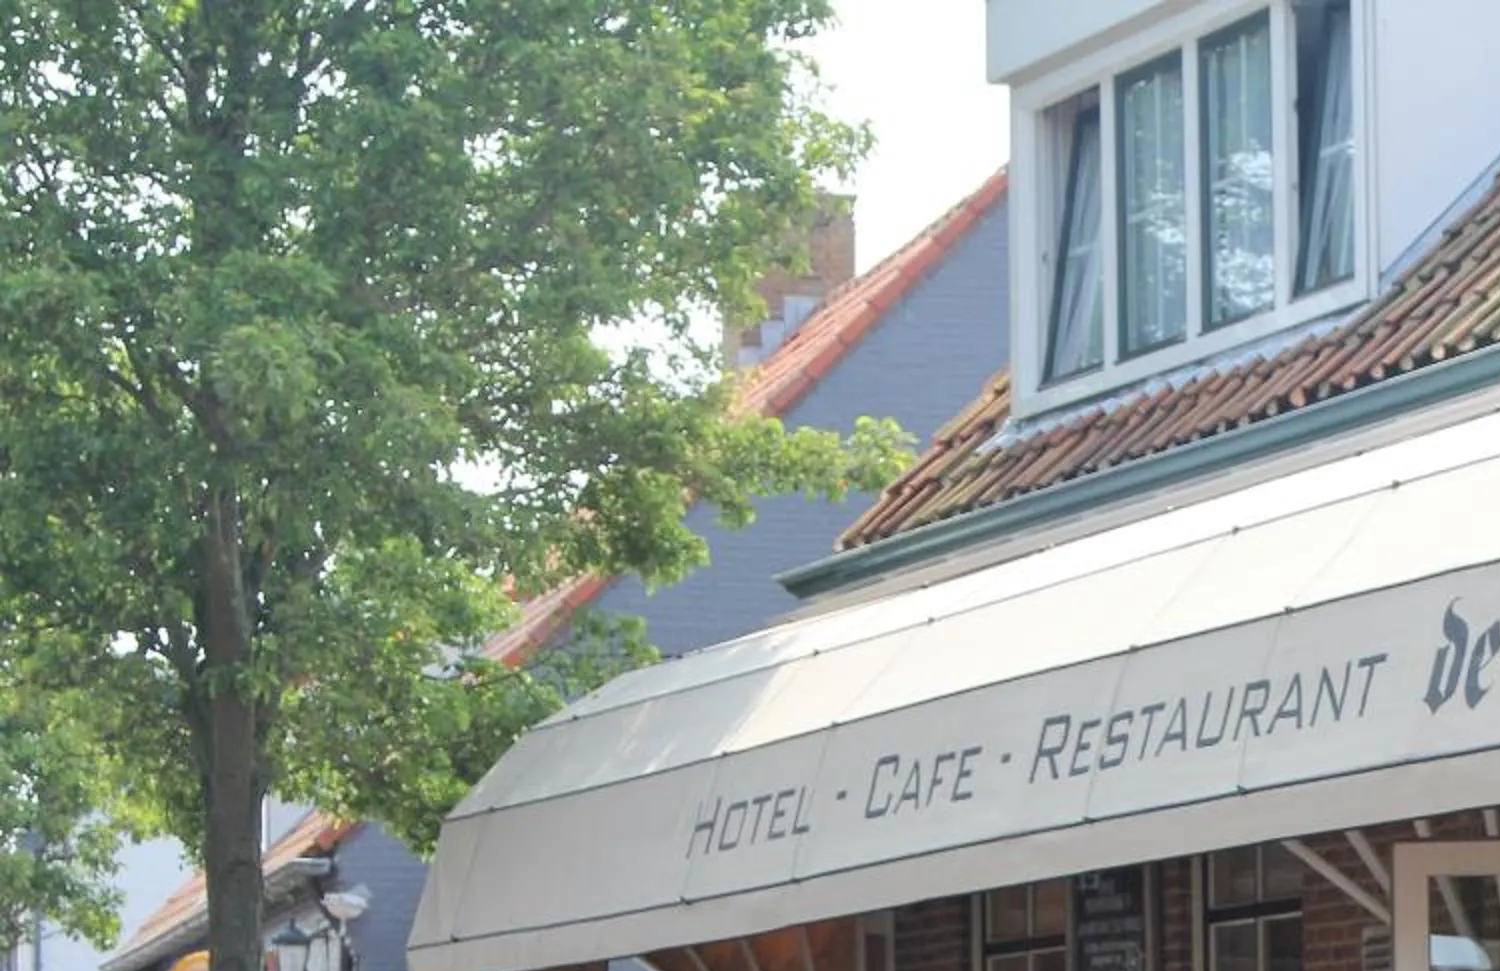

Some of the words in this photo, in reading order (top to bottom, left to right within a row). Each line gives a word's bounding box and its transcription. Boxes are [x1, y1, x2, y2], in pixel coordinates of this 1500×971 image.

[686, 785, 811, 861] HOTEL
[864, 746, 983, 819] CAFE
[1029, 653, 1389, 783] RESTAURANT
